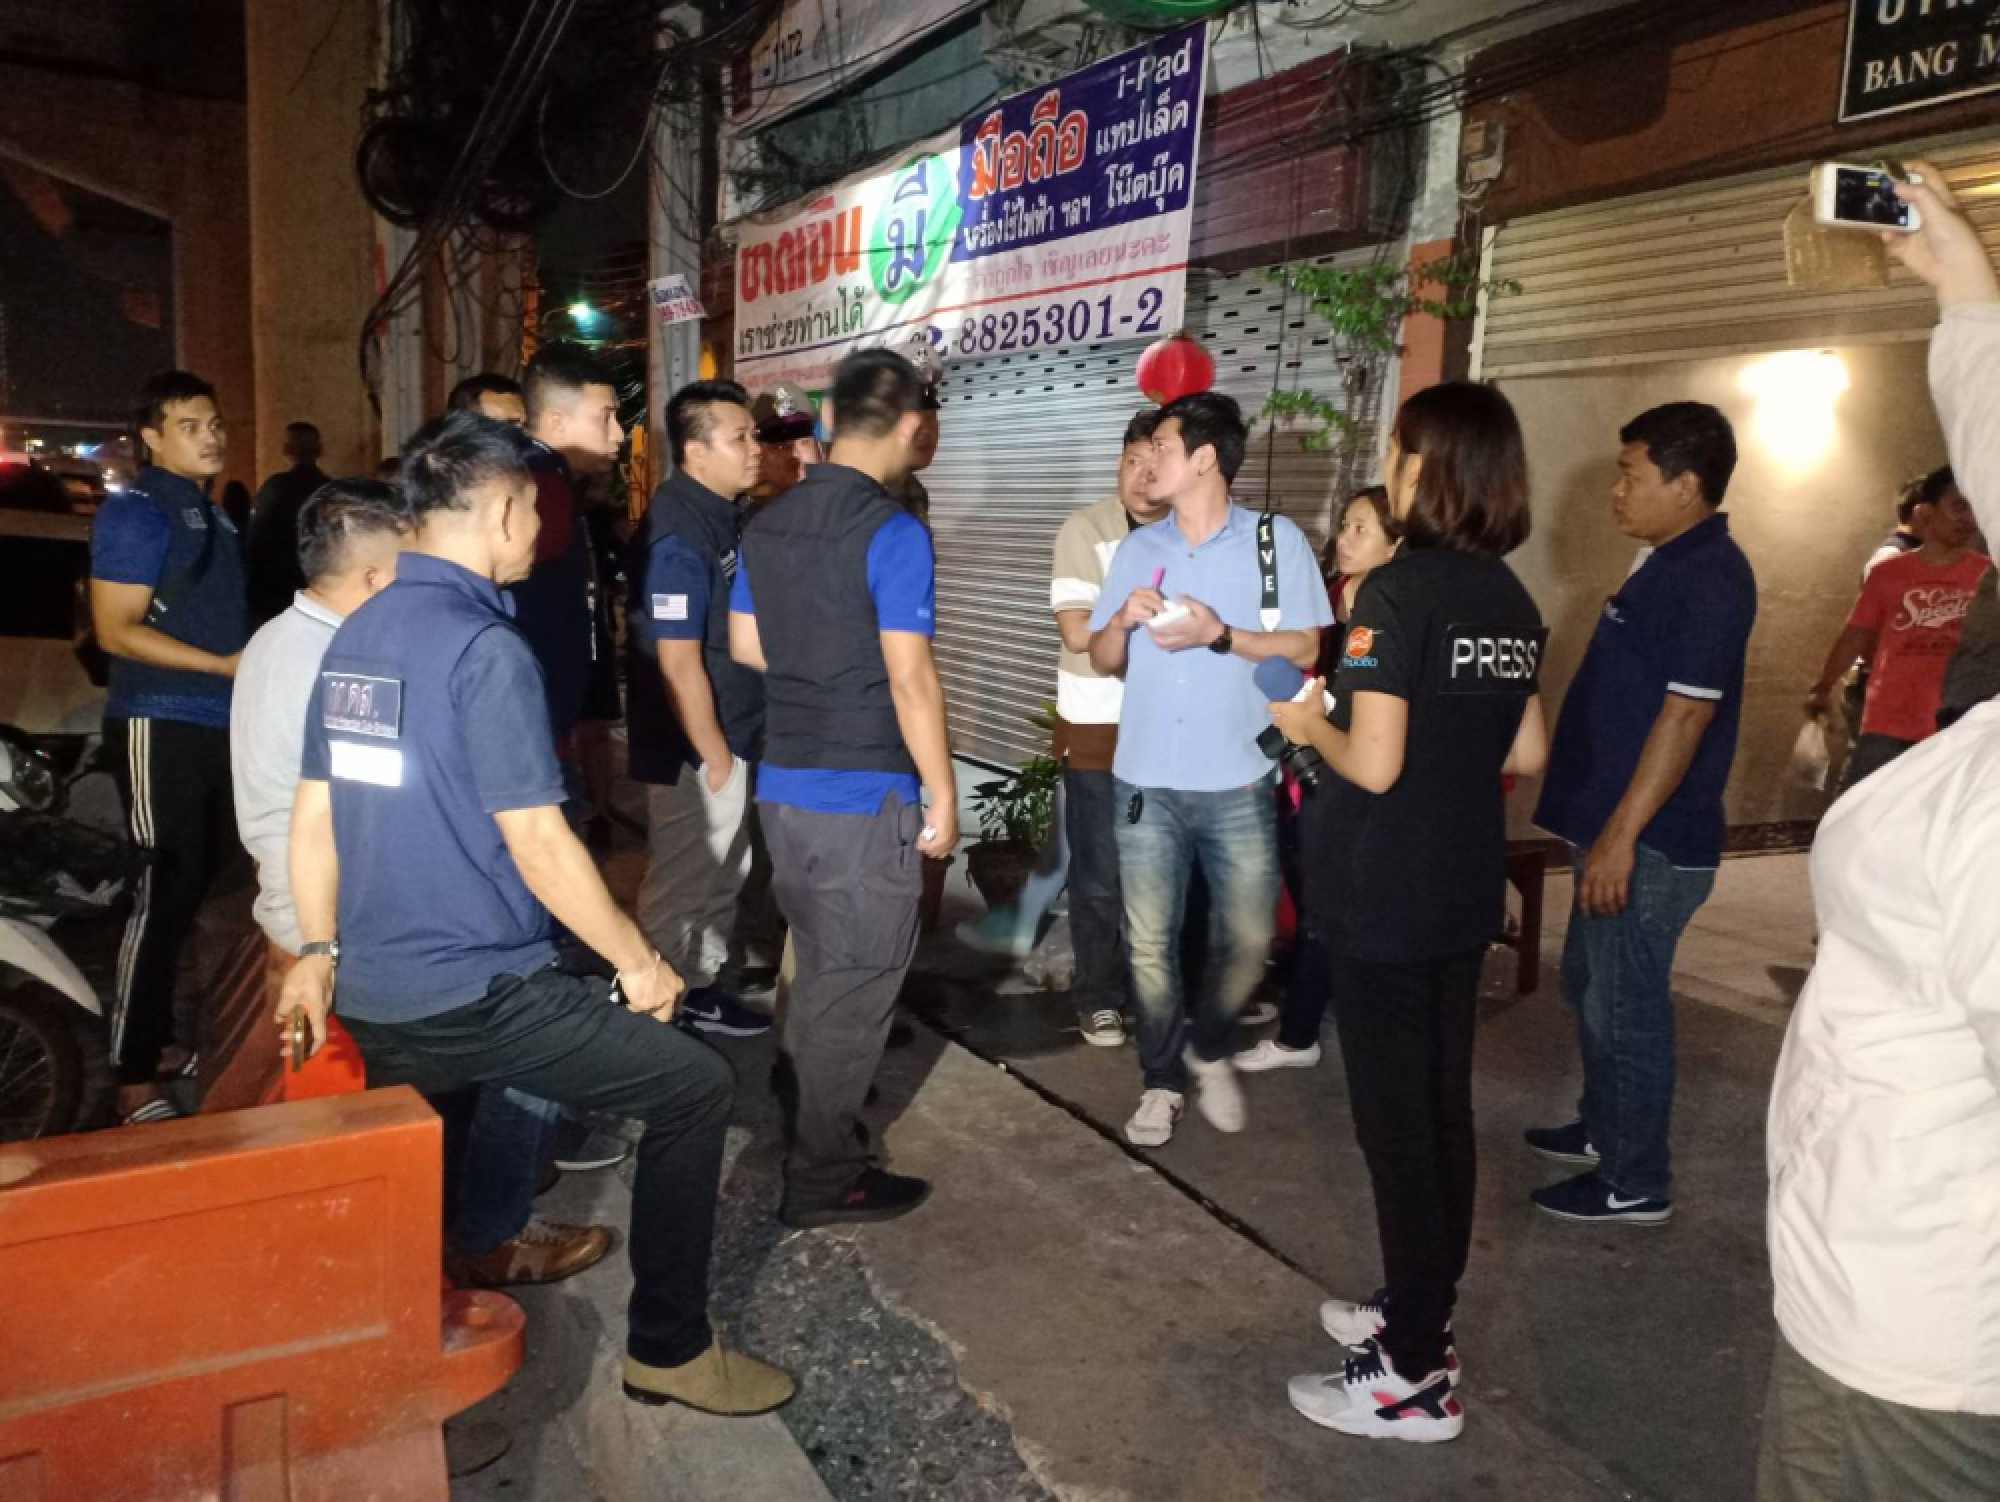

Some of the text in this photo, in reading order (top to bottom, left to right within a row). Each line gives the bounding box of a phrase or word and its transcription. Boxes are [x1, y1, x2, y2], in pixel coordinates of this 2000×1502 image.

[1117, 37, 1192, 98] i-Pad
[1863, 41, 1959, 93] BANG
[967, 87, 1090, 200] มือถือ
[886, 160, 929, 289] มี
[738, 286, 866, 355] เราช่วยท่านได้
[909, 286, 1164, 358] 2-8825301-2
[1450, 636, 1539, 679] PRESS
